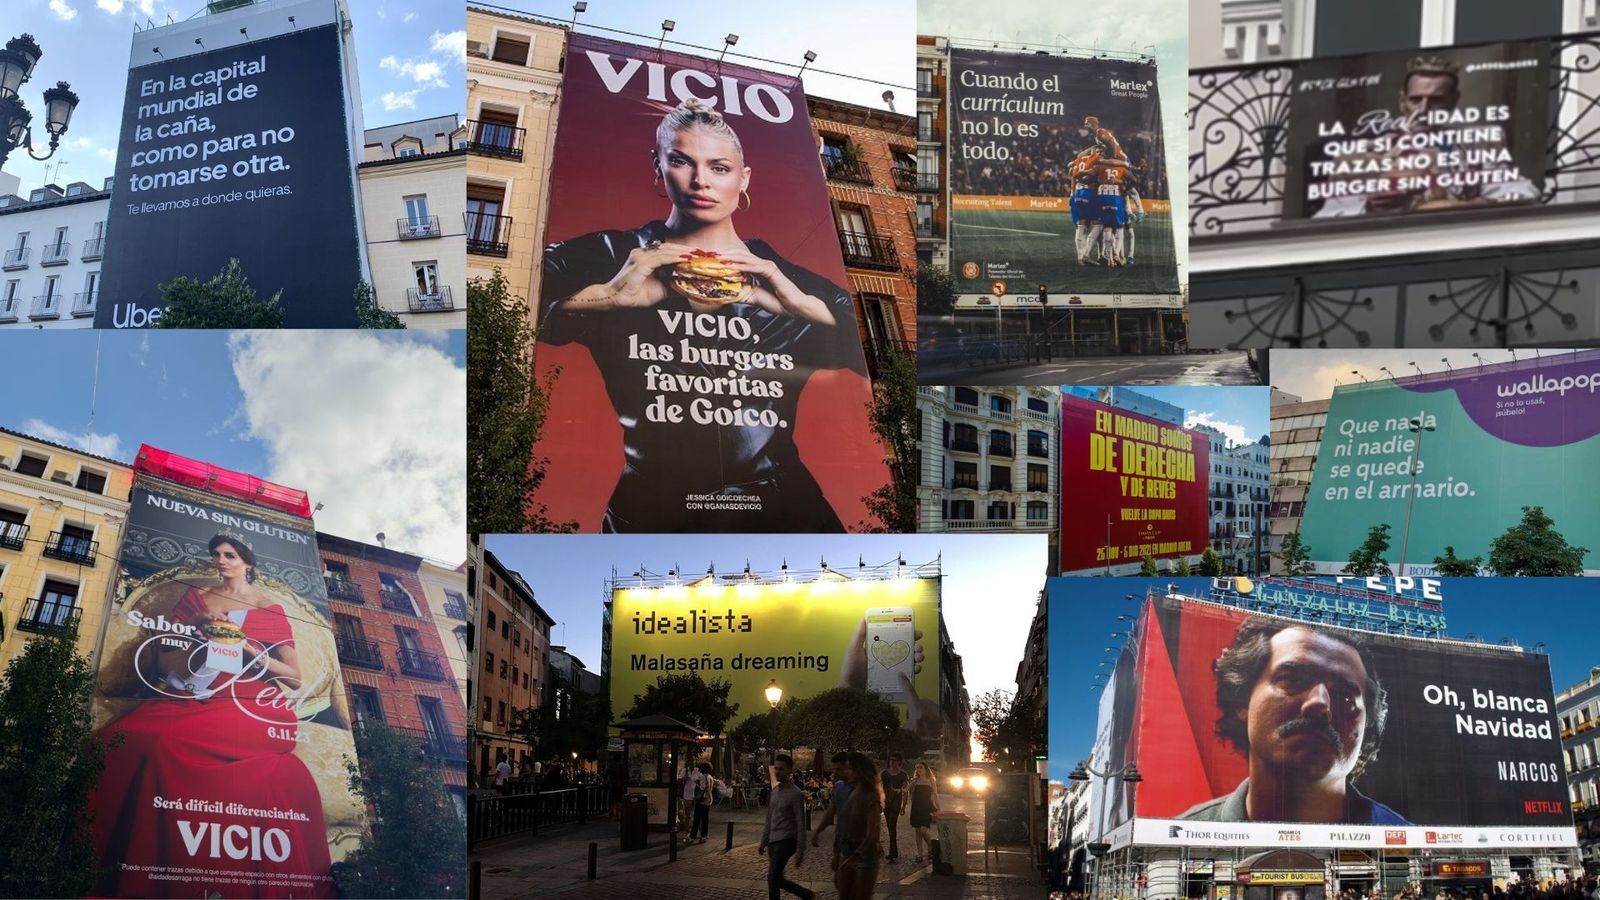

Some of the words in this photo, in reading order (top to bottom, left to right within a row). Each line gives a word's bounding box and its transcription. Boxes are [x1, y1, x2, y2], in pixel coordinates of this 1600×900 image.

[141, 78, 164, 97] En
[169, 74, 186, 92] la
[190, 56, 266, 87] capital
[586, 50, 794, 124] VICIO
[960, 70, 1038, 91] Cuando
[1042, 74, 1060, 92] el
[1110, 79, 1148, 91] Marlex
[138, 87, 222, 119] mundial
[227, 83, 258, 102] de
[961, 94, 1065, 115] currículum
[1128, 91, 1148, 99] People
[135, 124, 152, 142] la
[157, 115, 216, 139] caña,
[961, 120, 988, 135] no
[993, 117, 1013, 137] lo
[1017, 123, 1039, 137] es
[1318, 121, 1345, 137] LA
[1486, 105, 1510, 121] ES
[130, 142, 198, 167] como
[202, 133, 257, 161] para
[261, 126, 295, 146] no
[962, 142, 1014, 161] todo.
[1324, 141, 1367, 157] QUE
[1398, 127, 1501, 150] CONTIENE
[130, 161, 228, 192] tomarse
[232, 154, 291, 178] otra.
[1310, 158, 1392, 177] TRAZAS
[1399, 154, 1430, 171] NO
[1437, 151, 1460, 168] ES
[1467, 148, 1512, 164] UNA
[127, 203, 140, 215] Te
[141, 198, 190, 213] llevamos
[191, 198, 199, 207] a
[201, 190, 243, 206] donde
[245, 184, 293, 202] quieras.
[1308, 179, 1390, 200] BURGER
[1397, 174, 1430, 190] SIN
[1030, 200, 1058, 208] Marlex
[112, 303, 171, 329] Ube
[657, 309, 760, 344] VICIO,
[628, 334, 674, 362] las
[680, 339, 794, 371] burgers
[644, 365, 784, 399] favoritas
[1497, 373, 1600, 397] wallapop
[646, 395, 684, 423] de
[690, 398, 788, 429] Goico.
[1496, 401, 1503, 409] Si
[1095, 409, 1112, 434] EN
[1115, 414, 1158, 444] MADRID
[1160, 427, 1193, 451] SOMOS
[1339, 418, 1379, 437] Que
[1090, 432, 1118, 472] DE
[1122, 439, 1195, 483] DERECHA
[1334, 440, 1351, 456] ni
[1357, 435, 1415, 455] nadie
[1330, 463, 1351, 478] se
[1356, 456, 1424, 481] quede
[1120, 476, 1129, 497] Y
[1131, 476, 1145, 498] DE
[1325, 485, 1349, 500] en
[1355, 480, 1374, 499] el
[1379, 477, 1476, 499] armario.
[146, 494, 210, 521] NUEVA
[211, 512, 241, 528] SIN
[686, 502, 703, 510] CON
[1121, 508, 1140, 521] VUELVE
[1141, 508, 1148, 521] LA
[1096, 547, 1106, 561] 25
[1256, 583, 1370, 618] GONZALEZ
[1336, 576, 1442, 601] EPE
[126, 610, 197, 637] Sabor
[632, 609, 752, 635] idealista
[1389, 603, 1446, 629] BYASS
[161, 636, 192, 651] muy
[211, 646, 239, 658] VICIO
[630, 653, 724, 672] Malasaña
[731, 652, 829, 672] dreaming
[1423, 685, 1466, 710] Oh,
[1472, 688, 1548, 714] blanca
[267, 727, 311, 743] 6.11.23
[1456, 714, 1552, 740] Navidad
[1497, 760, 1559, 783] NARCOS
[153, 796, 183, 810] Será
[184, 798, 224, 814] difícil
[1524, 801, 1563, 815] NETFLIX
[176, 820, 292, 862] VICIO
[1185, 830, 1211, 839] THOR
[1214, 831, 1250, 840] EQUITIES
[1330, 832, 1371, 841] PALAZZO
[1437, 832, 1463, 840] Lartec
[1500, 833, 1564, 842] CORTEFIEL
